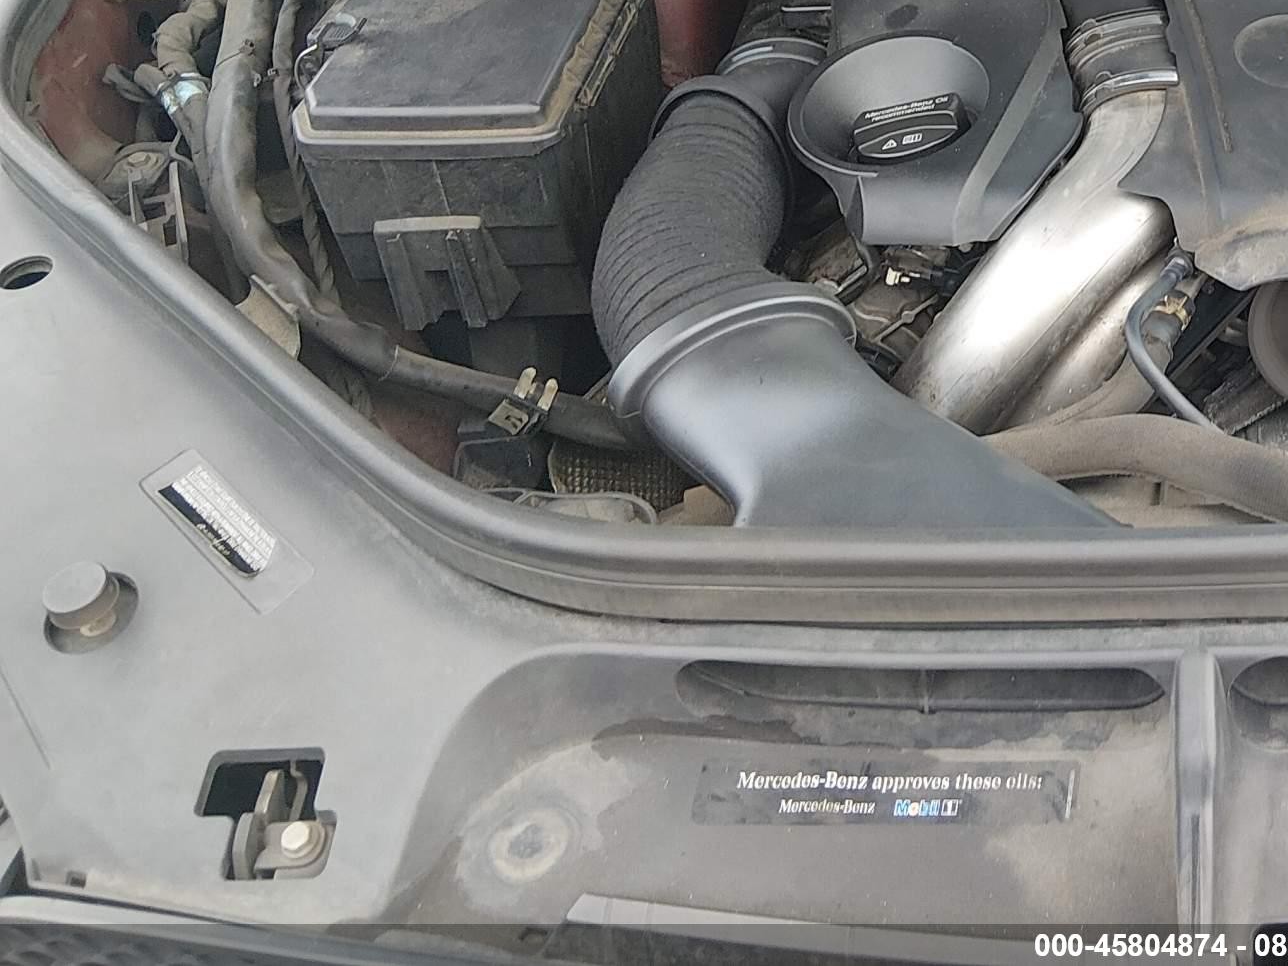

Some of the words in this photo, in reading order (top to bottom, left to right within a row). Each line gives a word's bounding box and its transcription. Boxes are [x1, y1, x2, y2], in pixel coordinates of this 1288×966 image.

[736, 771, 868, 790] Mercedes-Benz
[872, 774, 950, 793] approves
[955, 773, 1001, 790] these
[779, 799, 876, 814] Mercedes-Benz
[894, 799, 939, 816] Mobil
